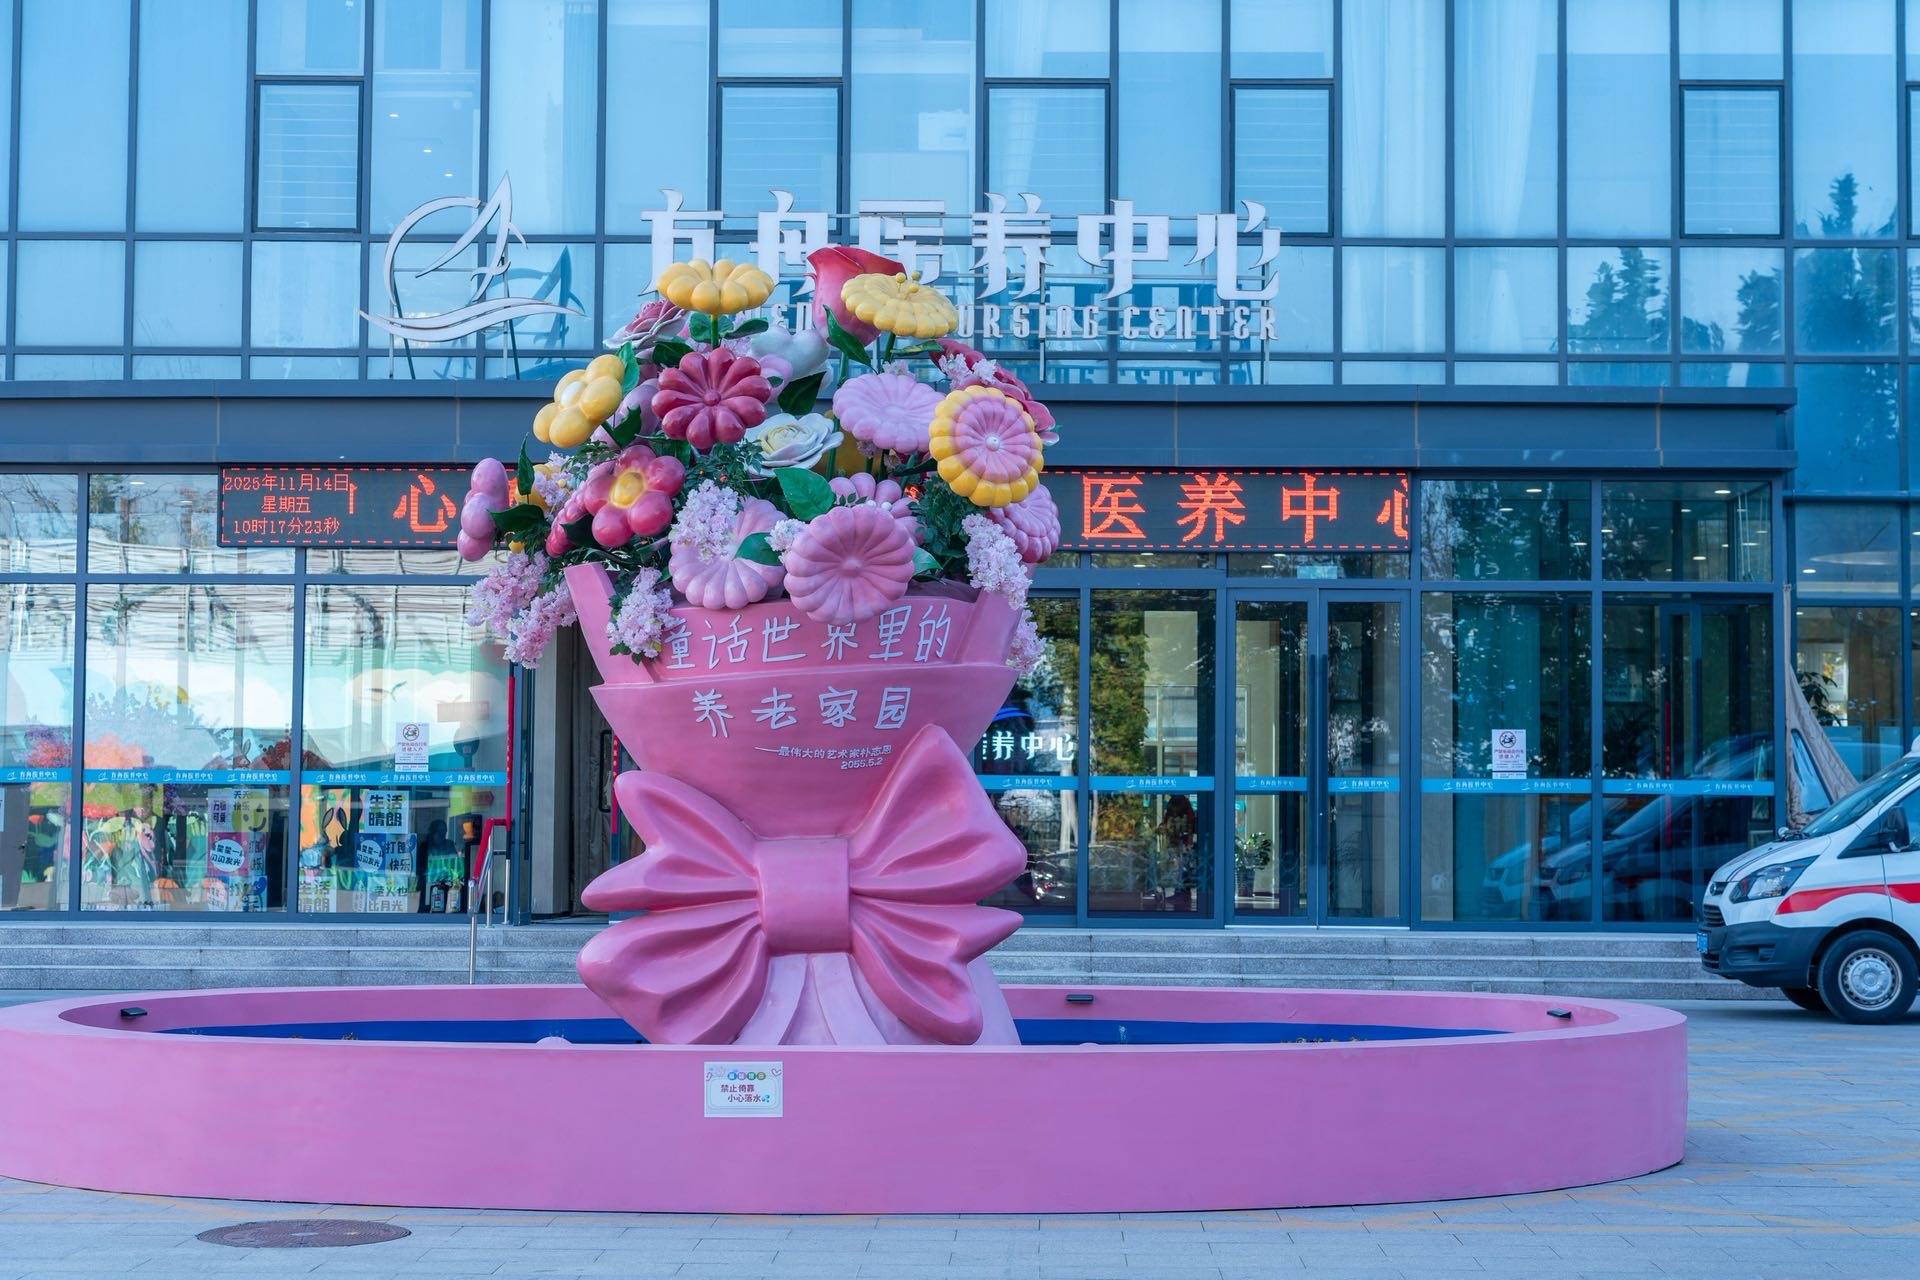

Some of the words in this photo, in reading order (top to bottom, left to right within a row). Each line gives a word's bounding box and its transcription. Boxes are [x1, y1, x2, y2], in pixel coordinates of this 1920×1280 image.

[956, 303, 1100, 339] URSING
[1122, 304, 1279, 340] CENTER
[224, 473, 349, 492] 2025年11月14日
[261, 496, 311, 513] 星期五
[233, 517, 340, 535] 10时17分23秒
[664, 604, 951, 671] 童话世界里的
[692, 686, 912, 738] 养老家园
[370, 794, 403, 809] 生活
[369, 812, 402, 827] 晴朗
